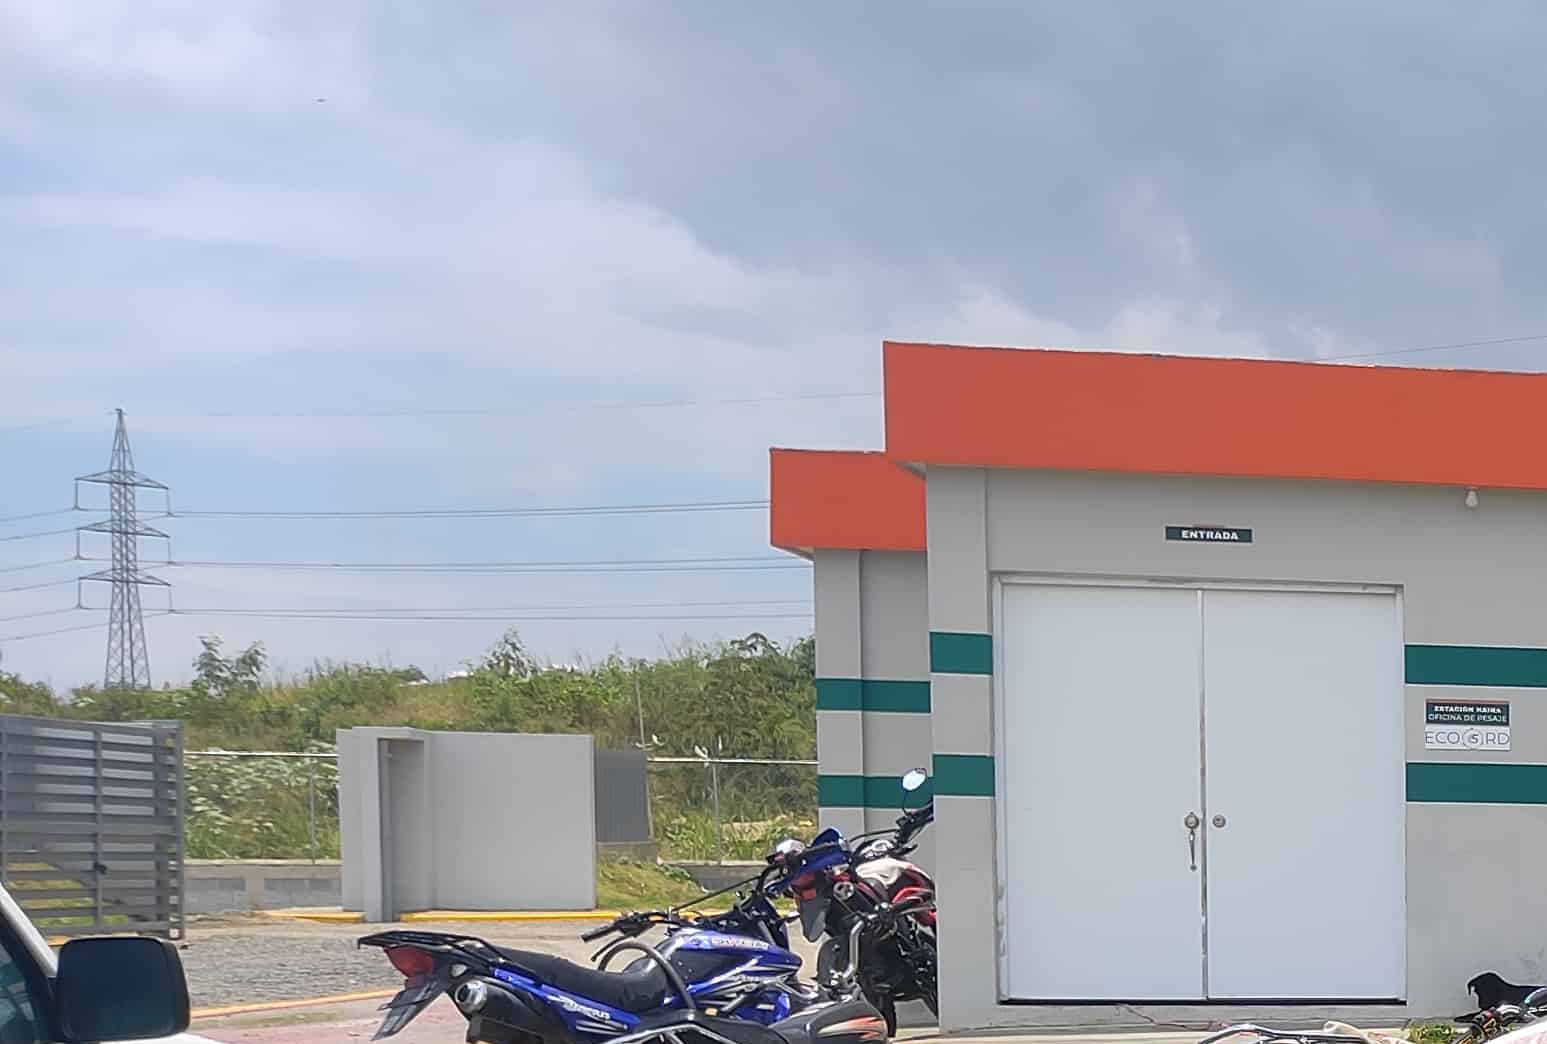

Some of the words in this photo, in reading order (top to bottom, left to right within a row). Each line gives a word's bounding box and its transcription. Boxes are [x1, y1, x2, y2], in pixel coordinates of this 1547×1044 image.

[1181, 530, 1239, 540] ENTRADA
[1428, 713, 1462, 721] OFICINA
[1463, 714, 1475, 722] DE
[1425, 731, 1460, 744] ECO
[1486, 732, 1509, 745] RD
